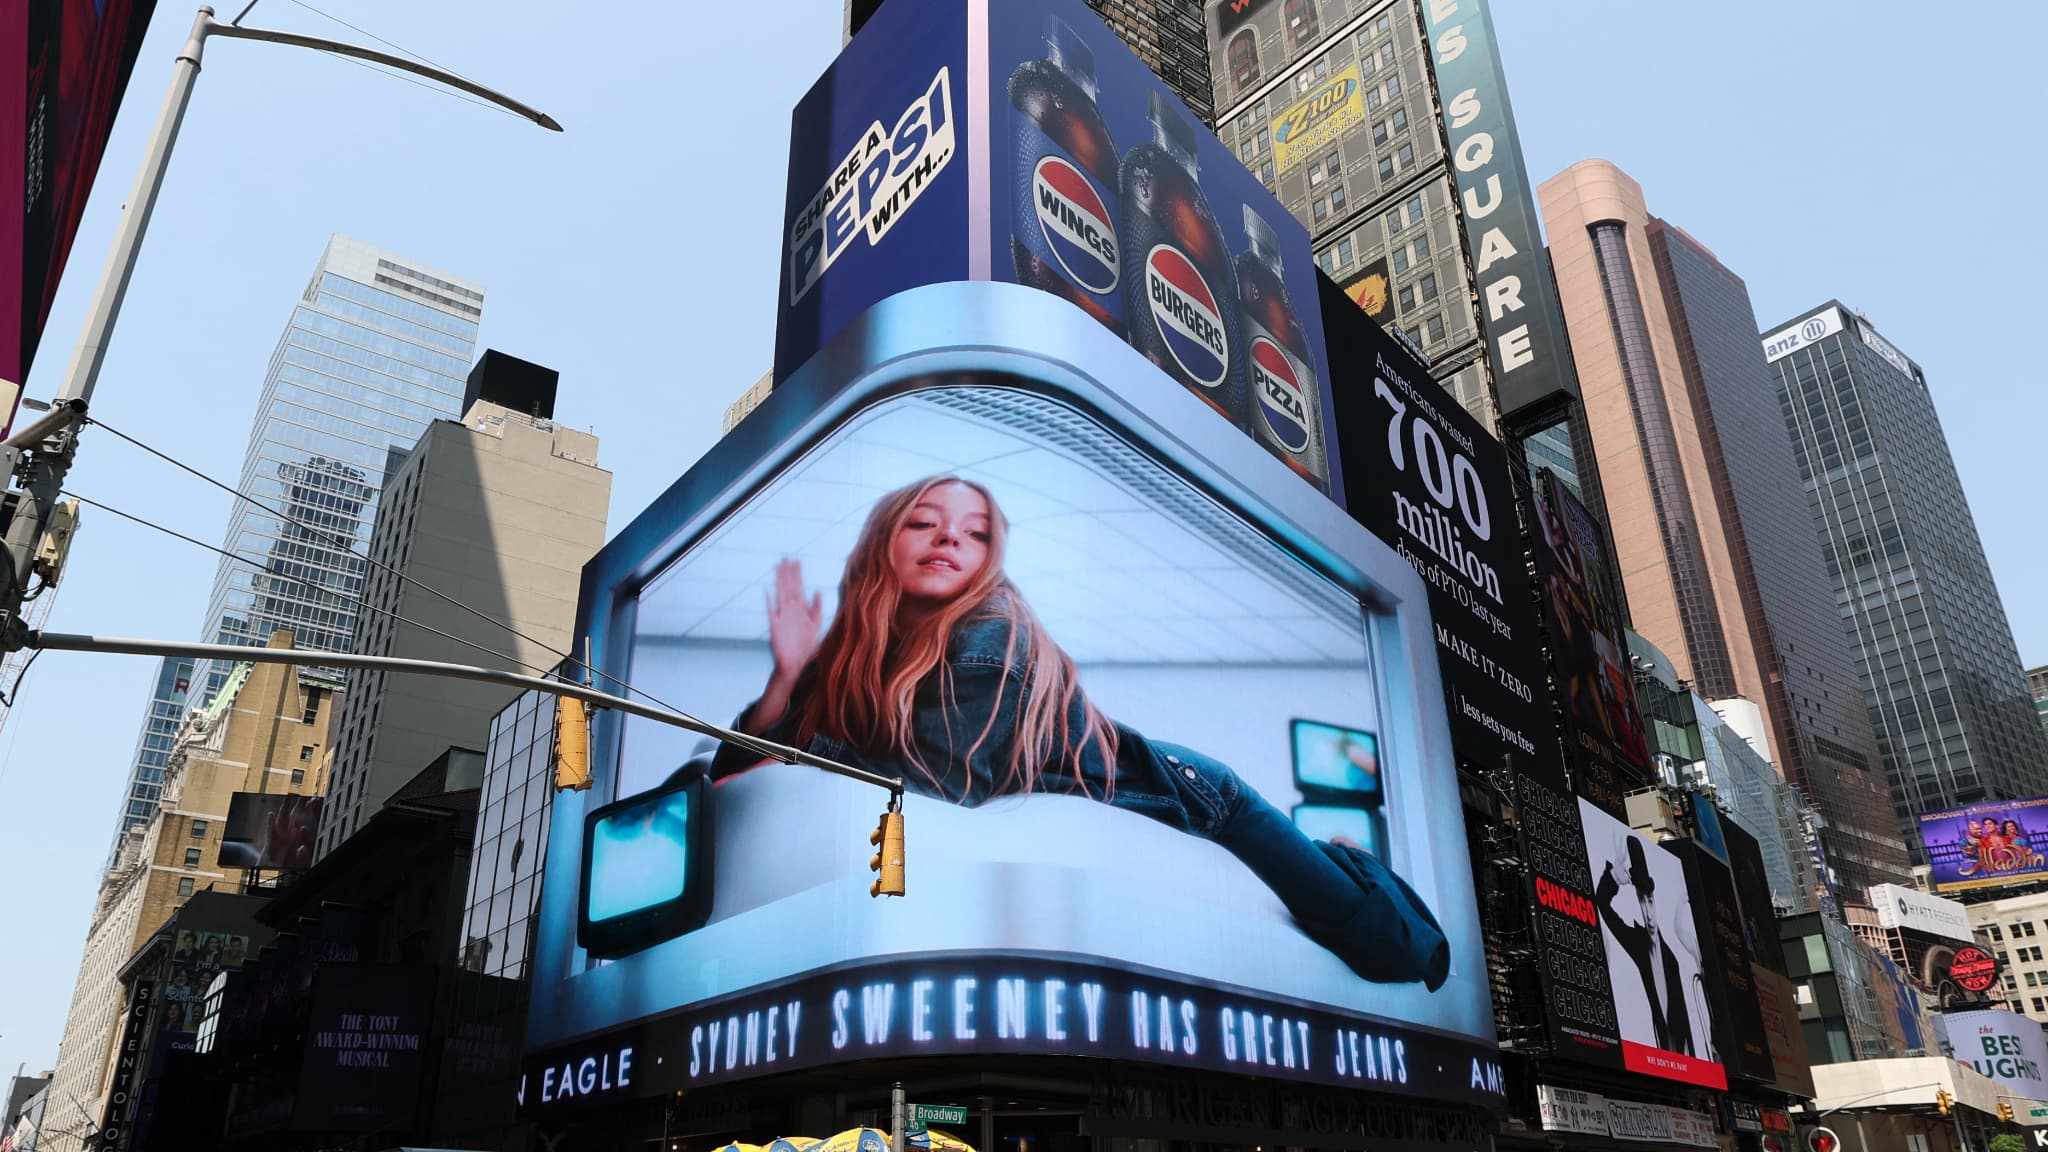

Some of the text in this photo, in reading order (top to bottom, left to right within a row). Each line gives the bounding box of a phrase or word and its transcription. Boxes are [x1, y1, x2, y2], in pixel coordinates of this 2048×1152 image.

[1286, 80, 1348, 143] Z100
[795, 130, 881, 242] SHARE A
[795, 78, 946, 298] PEPSI
[1038, 183, 1116, 264] WINGS
[1449, 88, 1534, 374] SQUARE
[1150, 272, 1224, 356] BURGERS
[1767, 333, 1800, 358] anz
[1252, 365, 1307, 425] PIZZA
[1375, 351, 1438, 421] Americans
[1438, 415, 1475, 457] wasted
[1374, 376, 1491, 542] 700
[1392, 490, 1504, 606] million
[1397, 537, 1512, 640] days of PTO last year
[1436, 623, 1532, 703] MAKE IT ZERO
[1461, 695, 1536, 755] less sets you free
[1517, 772, 1580, 831] CHICAGO
[1523, 806, 1586, 862] CHICAGO
[1529, 841, 1592, 895] CHICAGO
[1536, 876, 1597, 927] CHICAGO
[1909, 904, 1933, 921] HYATT
[1541, 911, 1603, 961] CHICAGO
[1547, 947, 1609, 995] CHICAGO
[341, 1014, 400, 1032] THE TONY
[1552, 984, 1615, 1030] CHICAGO
[1978, 1024, 1994, 1034] the
[313, 1032, 420, 1050] AWARD-WINNING
[336, 1051, 391, 1068] MUSICAL
[542, 1048, 633, 1102] EAGLE
[690, 1001, 801, 1079] SYDNEY
[832, 978, 1103, 1049] SWEENEY
[1132, 990, 1197, 1055] HAS
[1222, 1007, 1310, 1071] GREAT
[1336, 1028, 1407, 1084] JEANS
[1981, 1035, 2023, 1056] BES
[918, 1107, 964, 1123] Broadway
